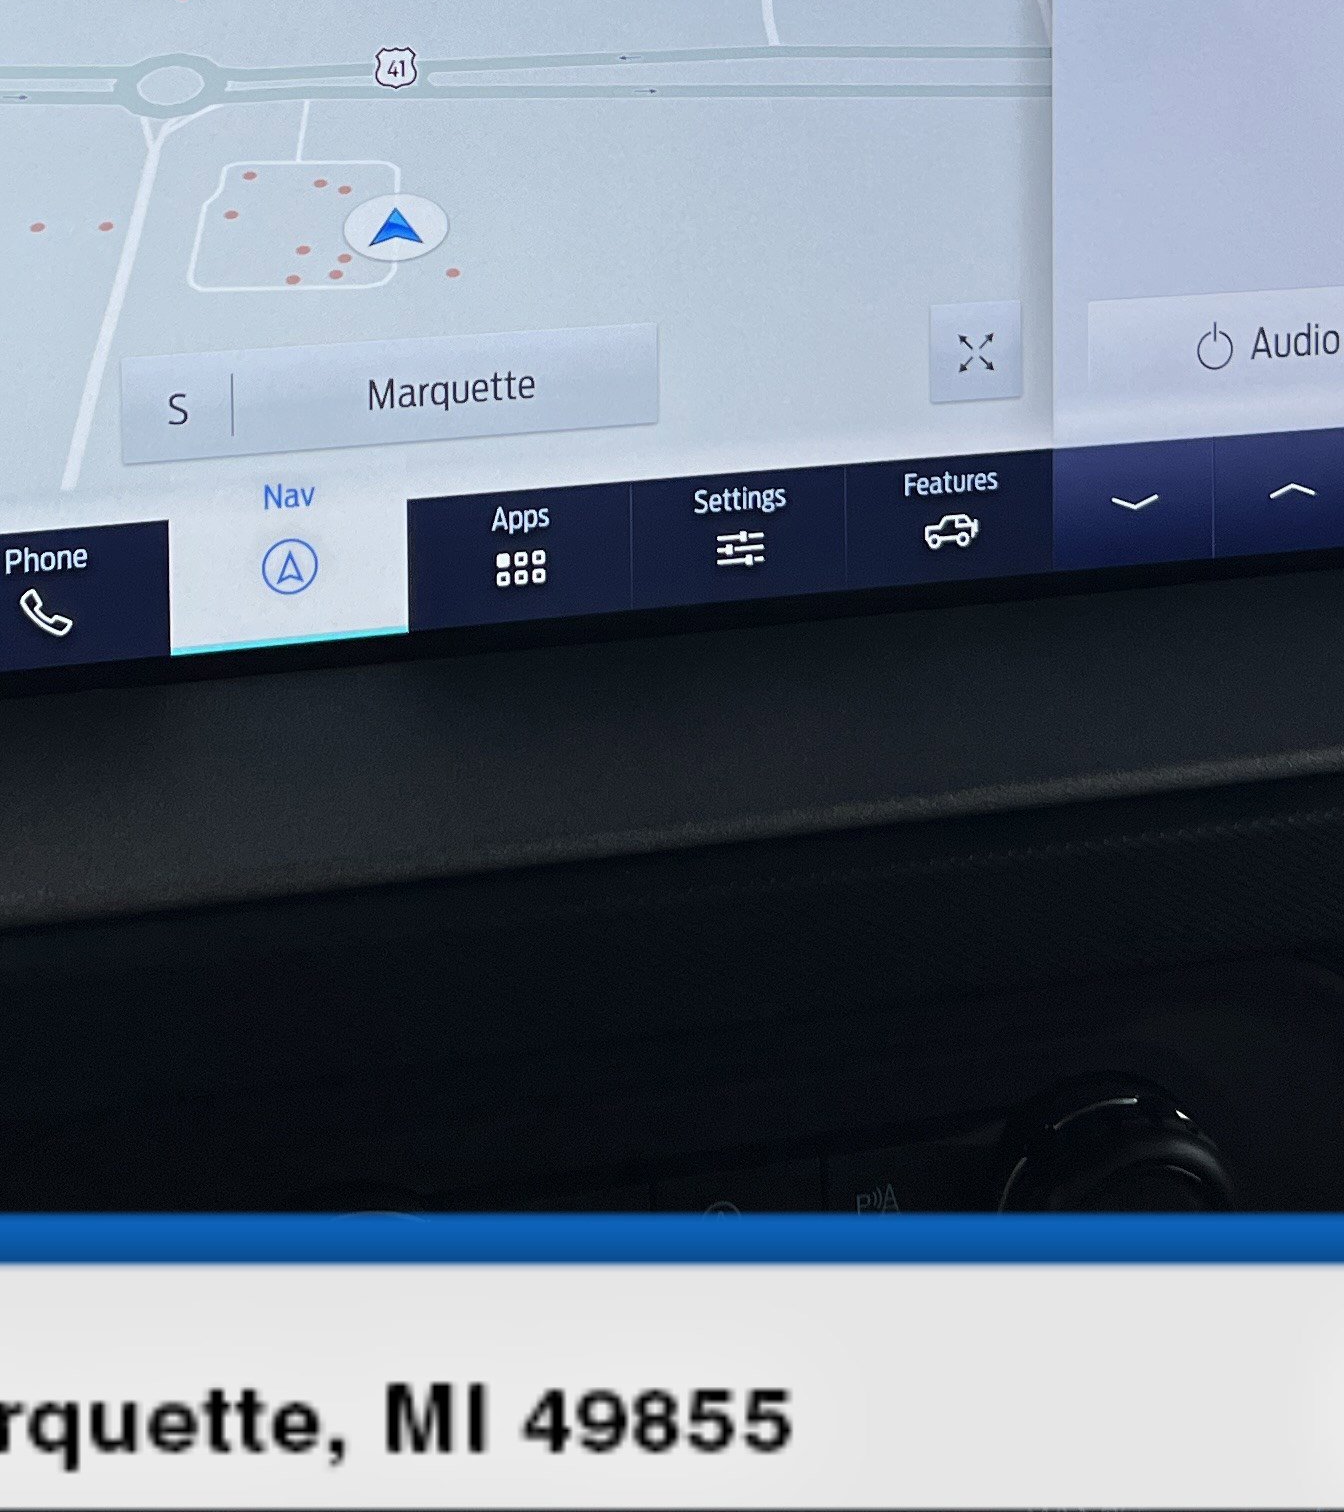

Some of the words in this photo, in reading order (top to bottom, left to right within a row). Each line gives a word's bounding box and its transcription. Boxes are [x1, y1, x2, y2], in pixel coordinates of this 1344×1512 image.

[387, 59, 407, 79] 41
[1249, 321, 1341, 361] Audio
[367, 369, 537, 412] Marquette
[167, 392, 189, 427] S
[263, 482, 316, 511] Nav
[903, 469, 999, 498] Features
[693, 485, 787, 515] Settings
[490, 505, 551, 536] Apps
[4, 545, 89, 576] Phone
